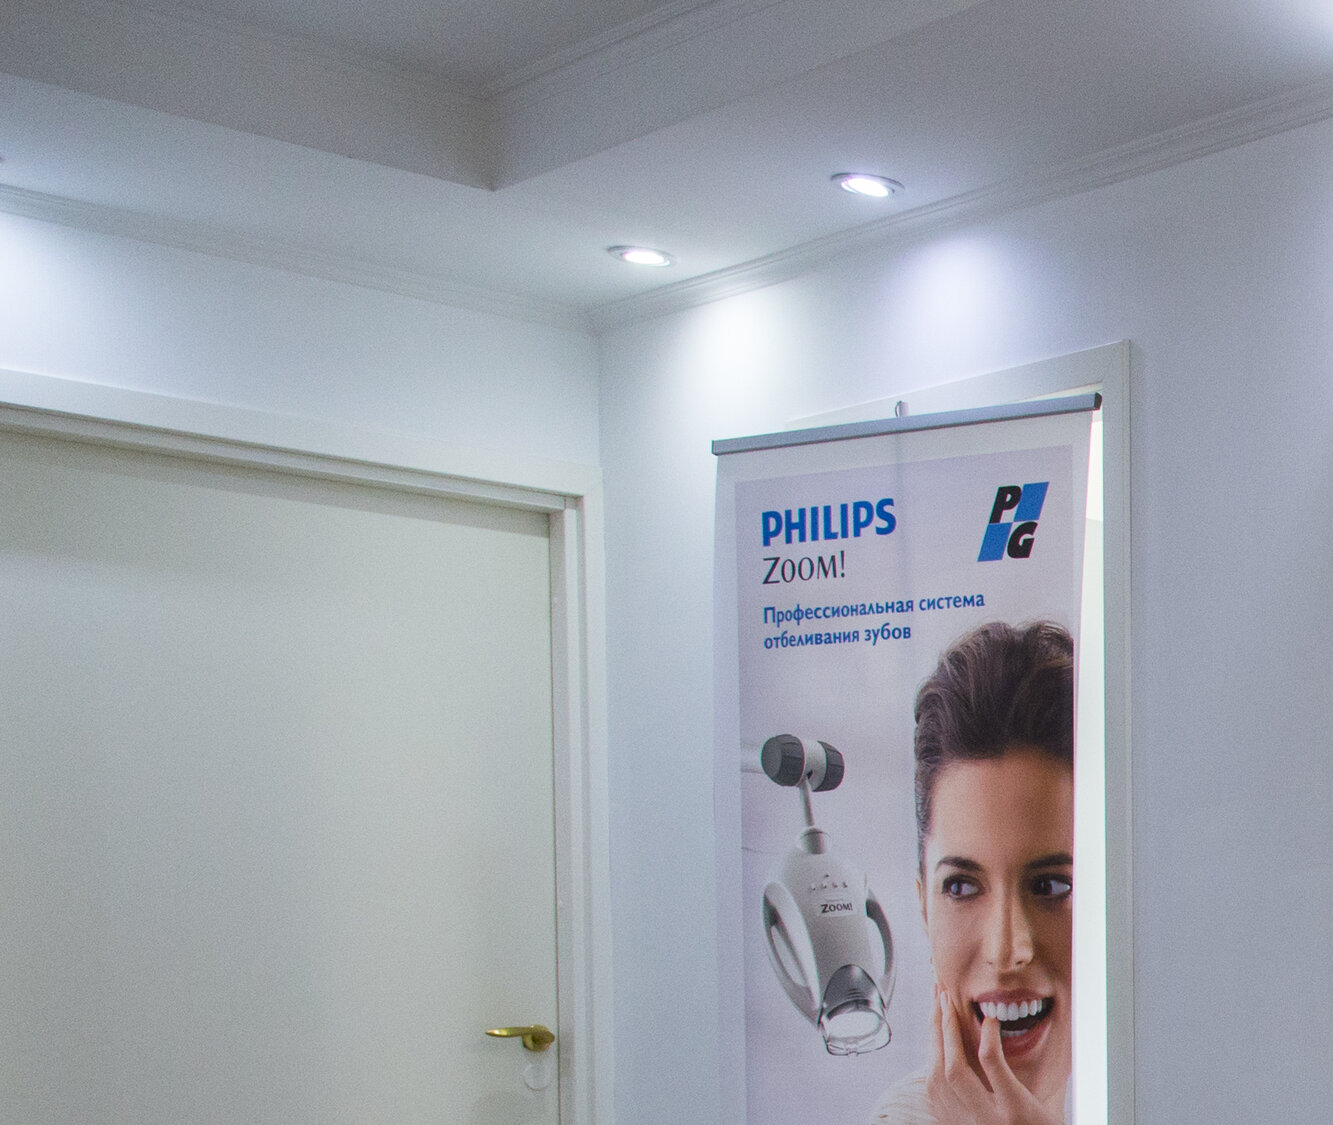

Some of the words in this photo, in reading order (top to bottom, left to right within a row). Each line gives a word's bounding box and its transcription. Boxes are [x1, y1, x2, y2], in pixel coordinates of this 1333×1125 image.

[762, 498, 897, 547] PHILIPS
[764, 599, 914, 628] Профессиональная
[919, 594, 986, 611] система
[764, 629, 860, 650] отбеливания
[865, 623, 912, 646] зубов
